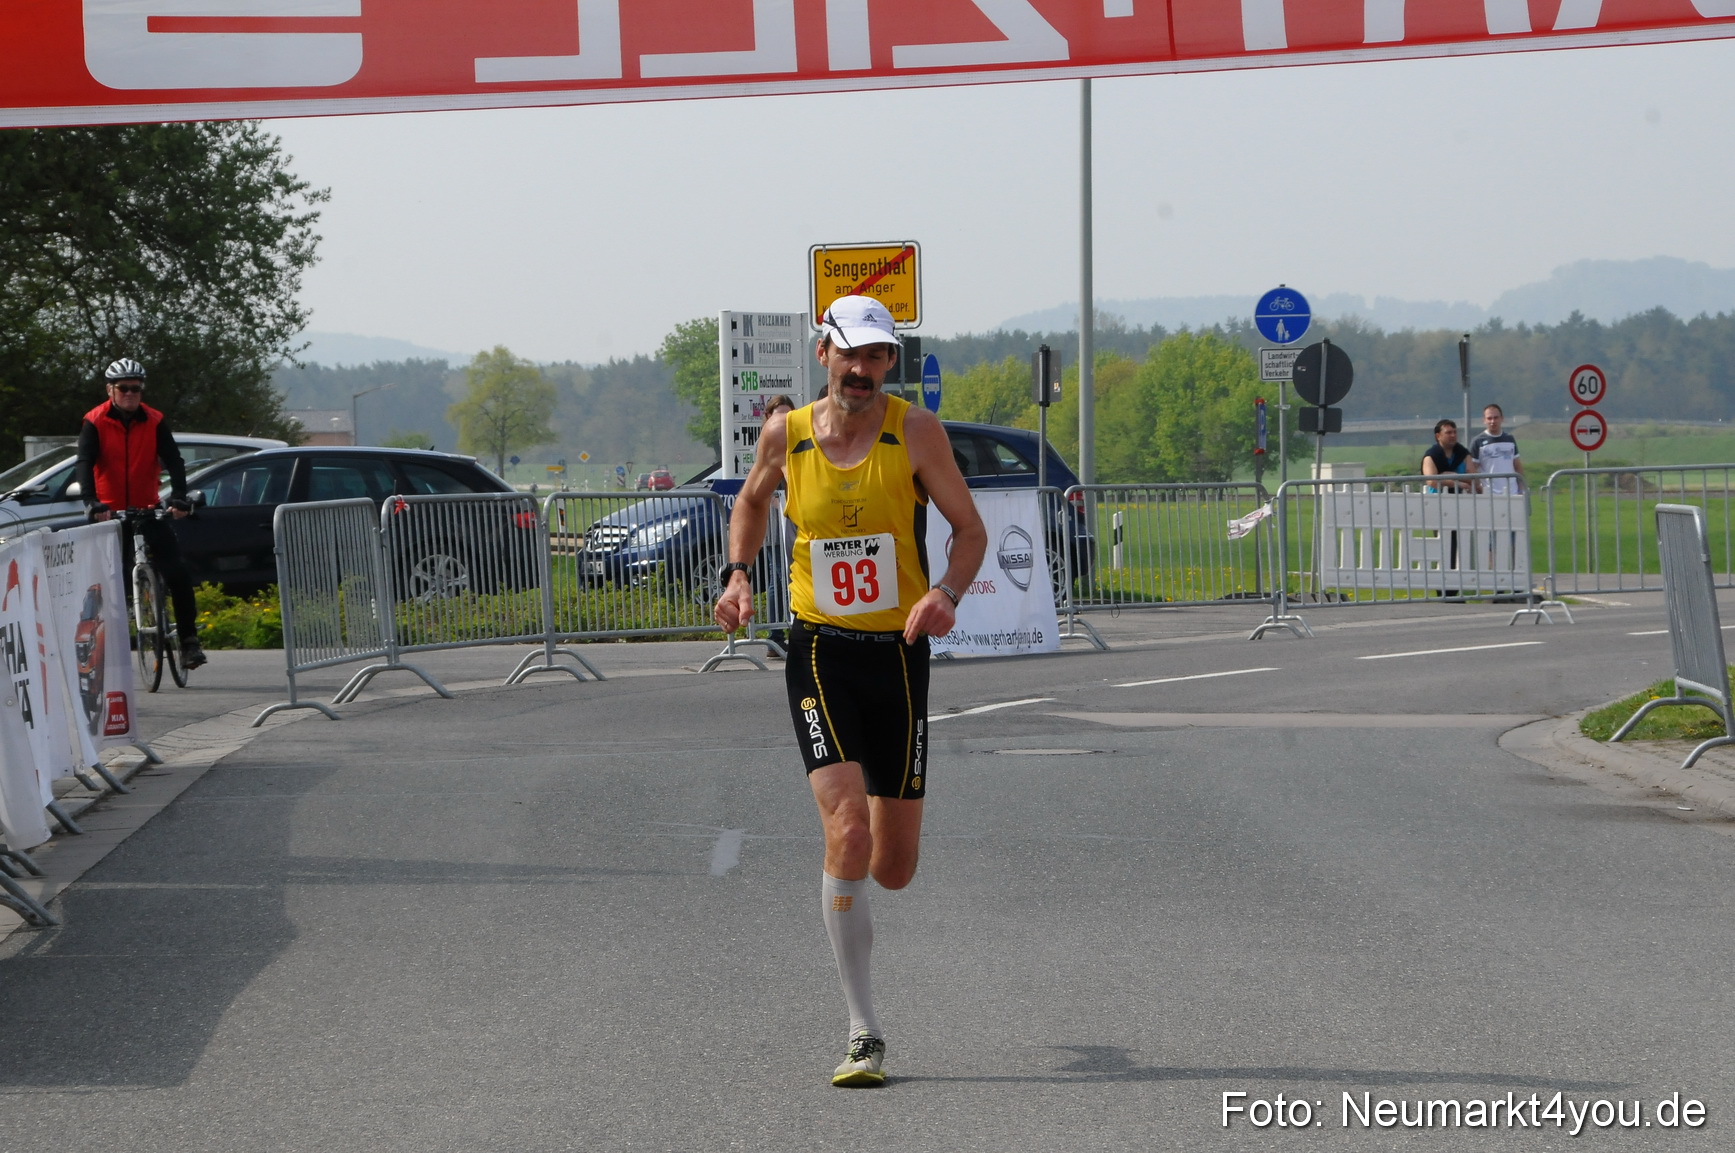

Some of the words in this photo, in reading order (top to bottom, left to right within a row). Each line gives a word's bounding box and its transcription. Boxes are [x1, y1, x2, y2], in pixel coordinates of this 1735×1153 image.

[824, 256, 907, 282] Sengenthal
[835, 284, 853, 295] am
[859, 282, 896, 296] Anger
[757, 315, 791, 327] HOLZAMMER
[758, 342, 792, 355] HOLZAMMER
[1265, 369, 1289, 378] Verkehr
[741, 371, 758, 391] SHB
[1577, 375, 1598, 395] 60
[824, 539, 862, 551] MEYER
[824, 549, 863, 558] WERBUNG
[831, 558, 880, 607] 93
[964, 580, 996, 595] OTORS
[111, 714, 125, 722] KIA
[804, 708, 829, 760] SKINS
[914, 718, 924, 775] SKINS
